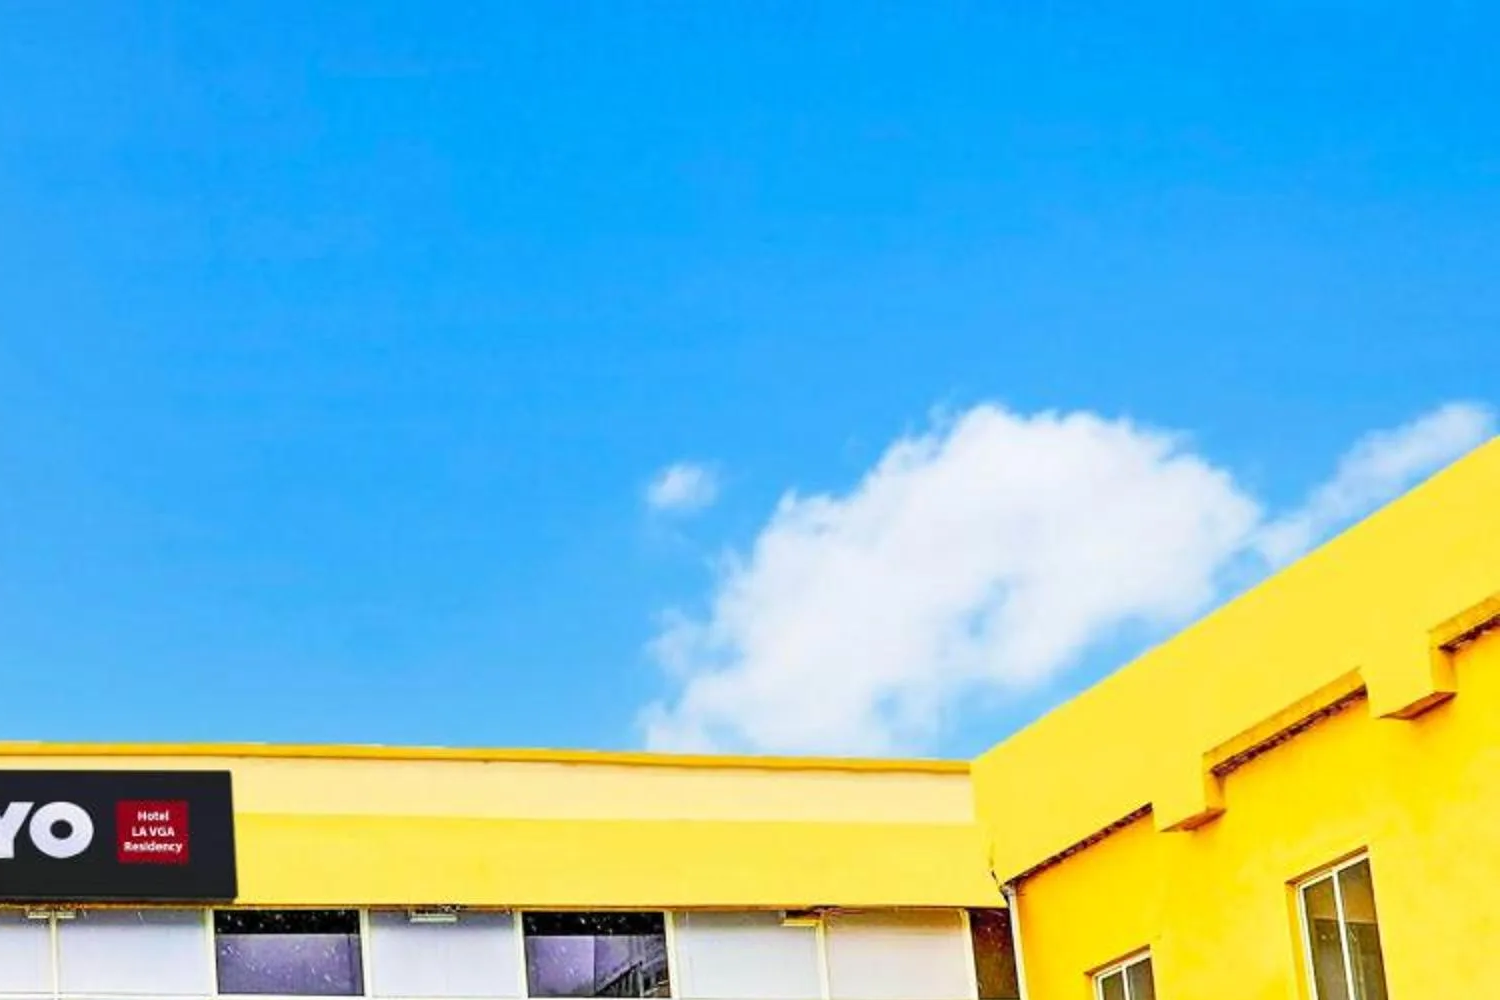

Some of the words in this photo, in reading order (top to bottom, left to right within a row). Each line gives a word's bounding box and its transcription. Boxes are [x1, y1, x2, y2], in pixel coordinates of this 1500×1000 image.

[137, 810, 169, 821] Hotel
[132, 826, 147, 837] LA
[149, 826, 175, 837] VGA
[124, 841, 182, 855] Residency
